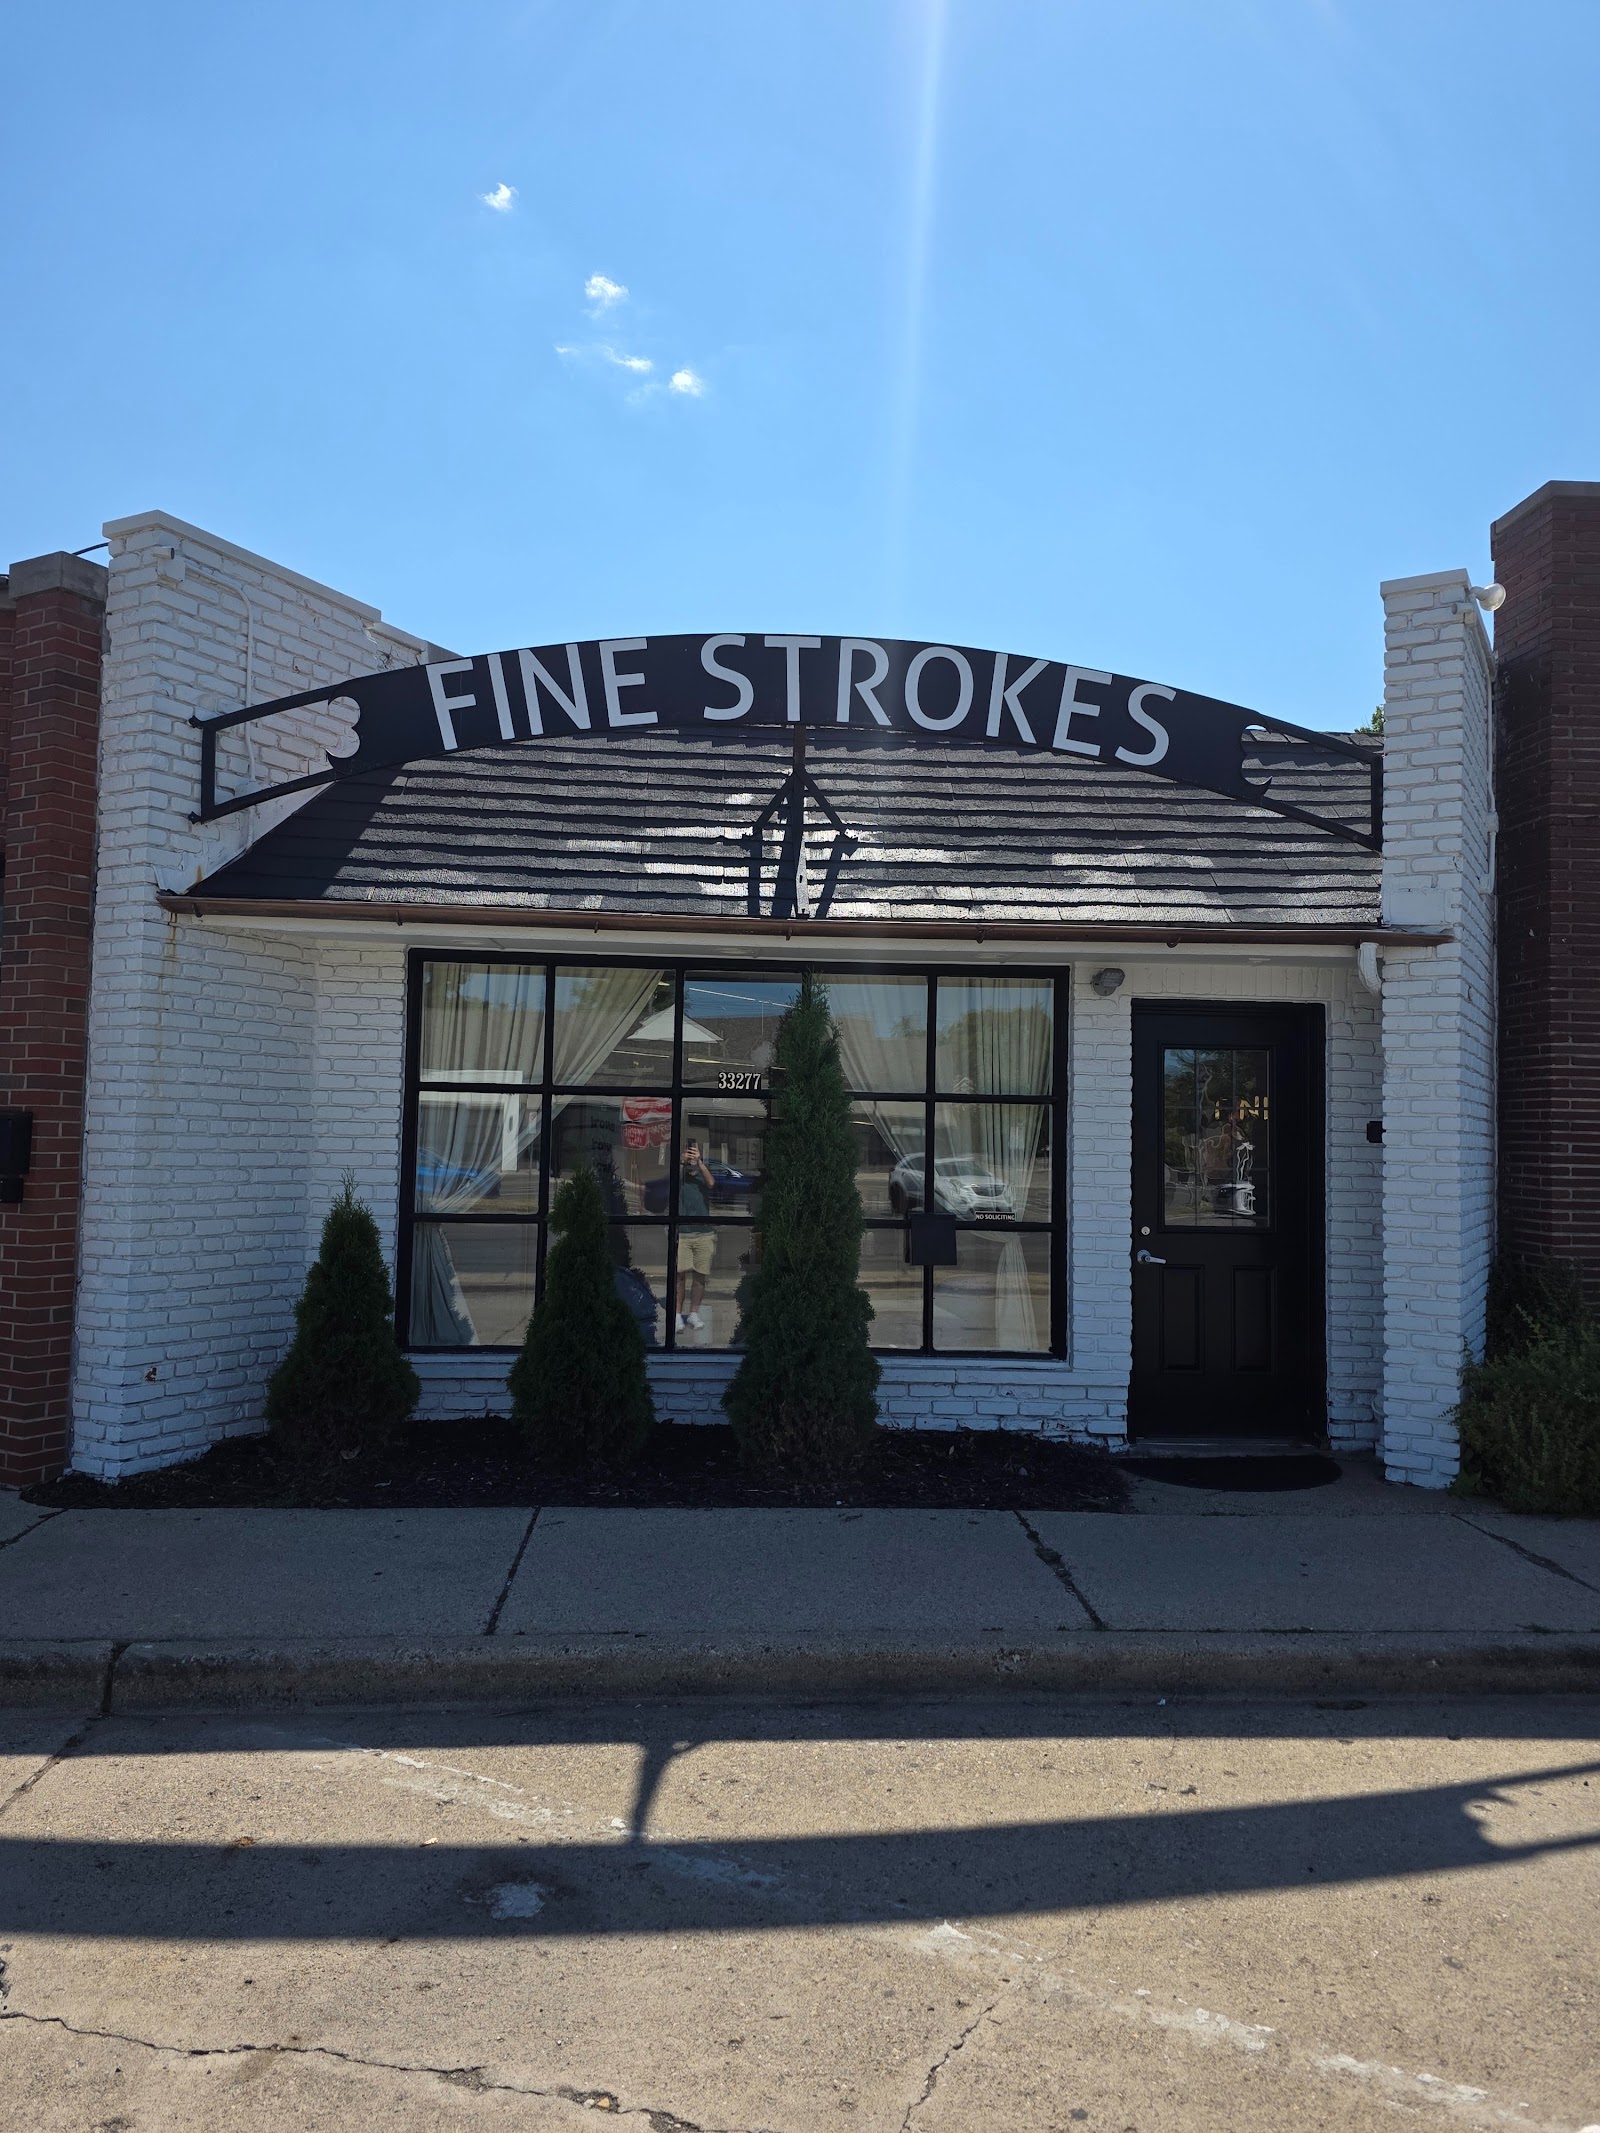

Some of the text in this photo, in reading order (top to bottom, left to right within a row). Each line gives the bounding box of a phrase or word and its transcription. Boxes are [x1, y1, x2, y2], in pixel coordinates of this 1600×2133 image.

[425, 633, 1177, 767] FINE STROKES
[718, 1072, 761, 1090] 33277
